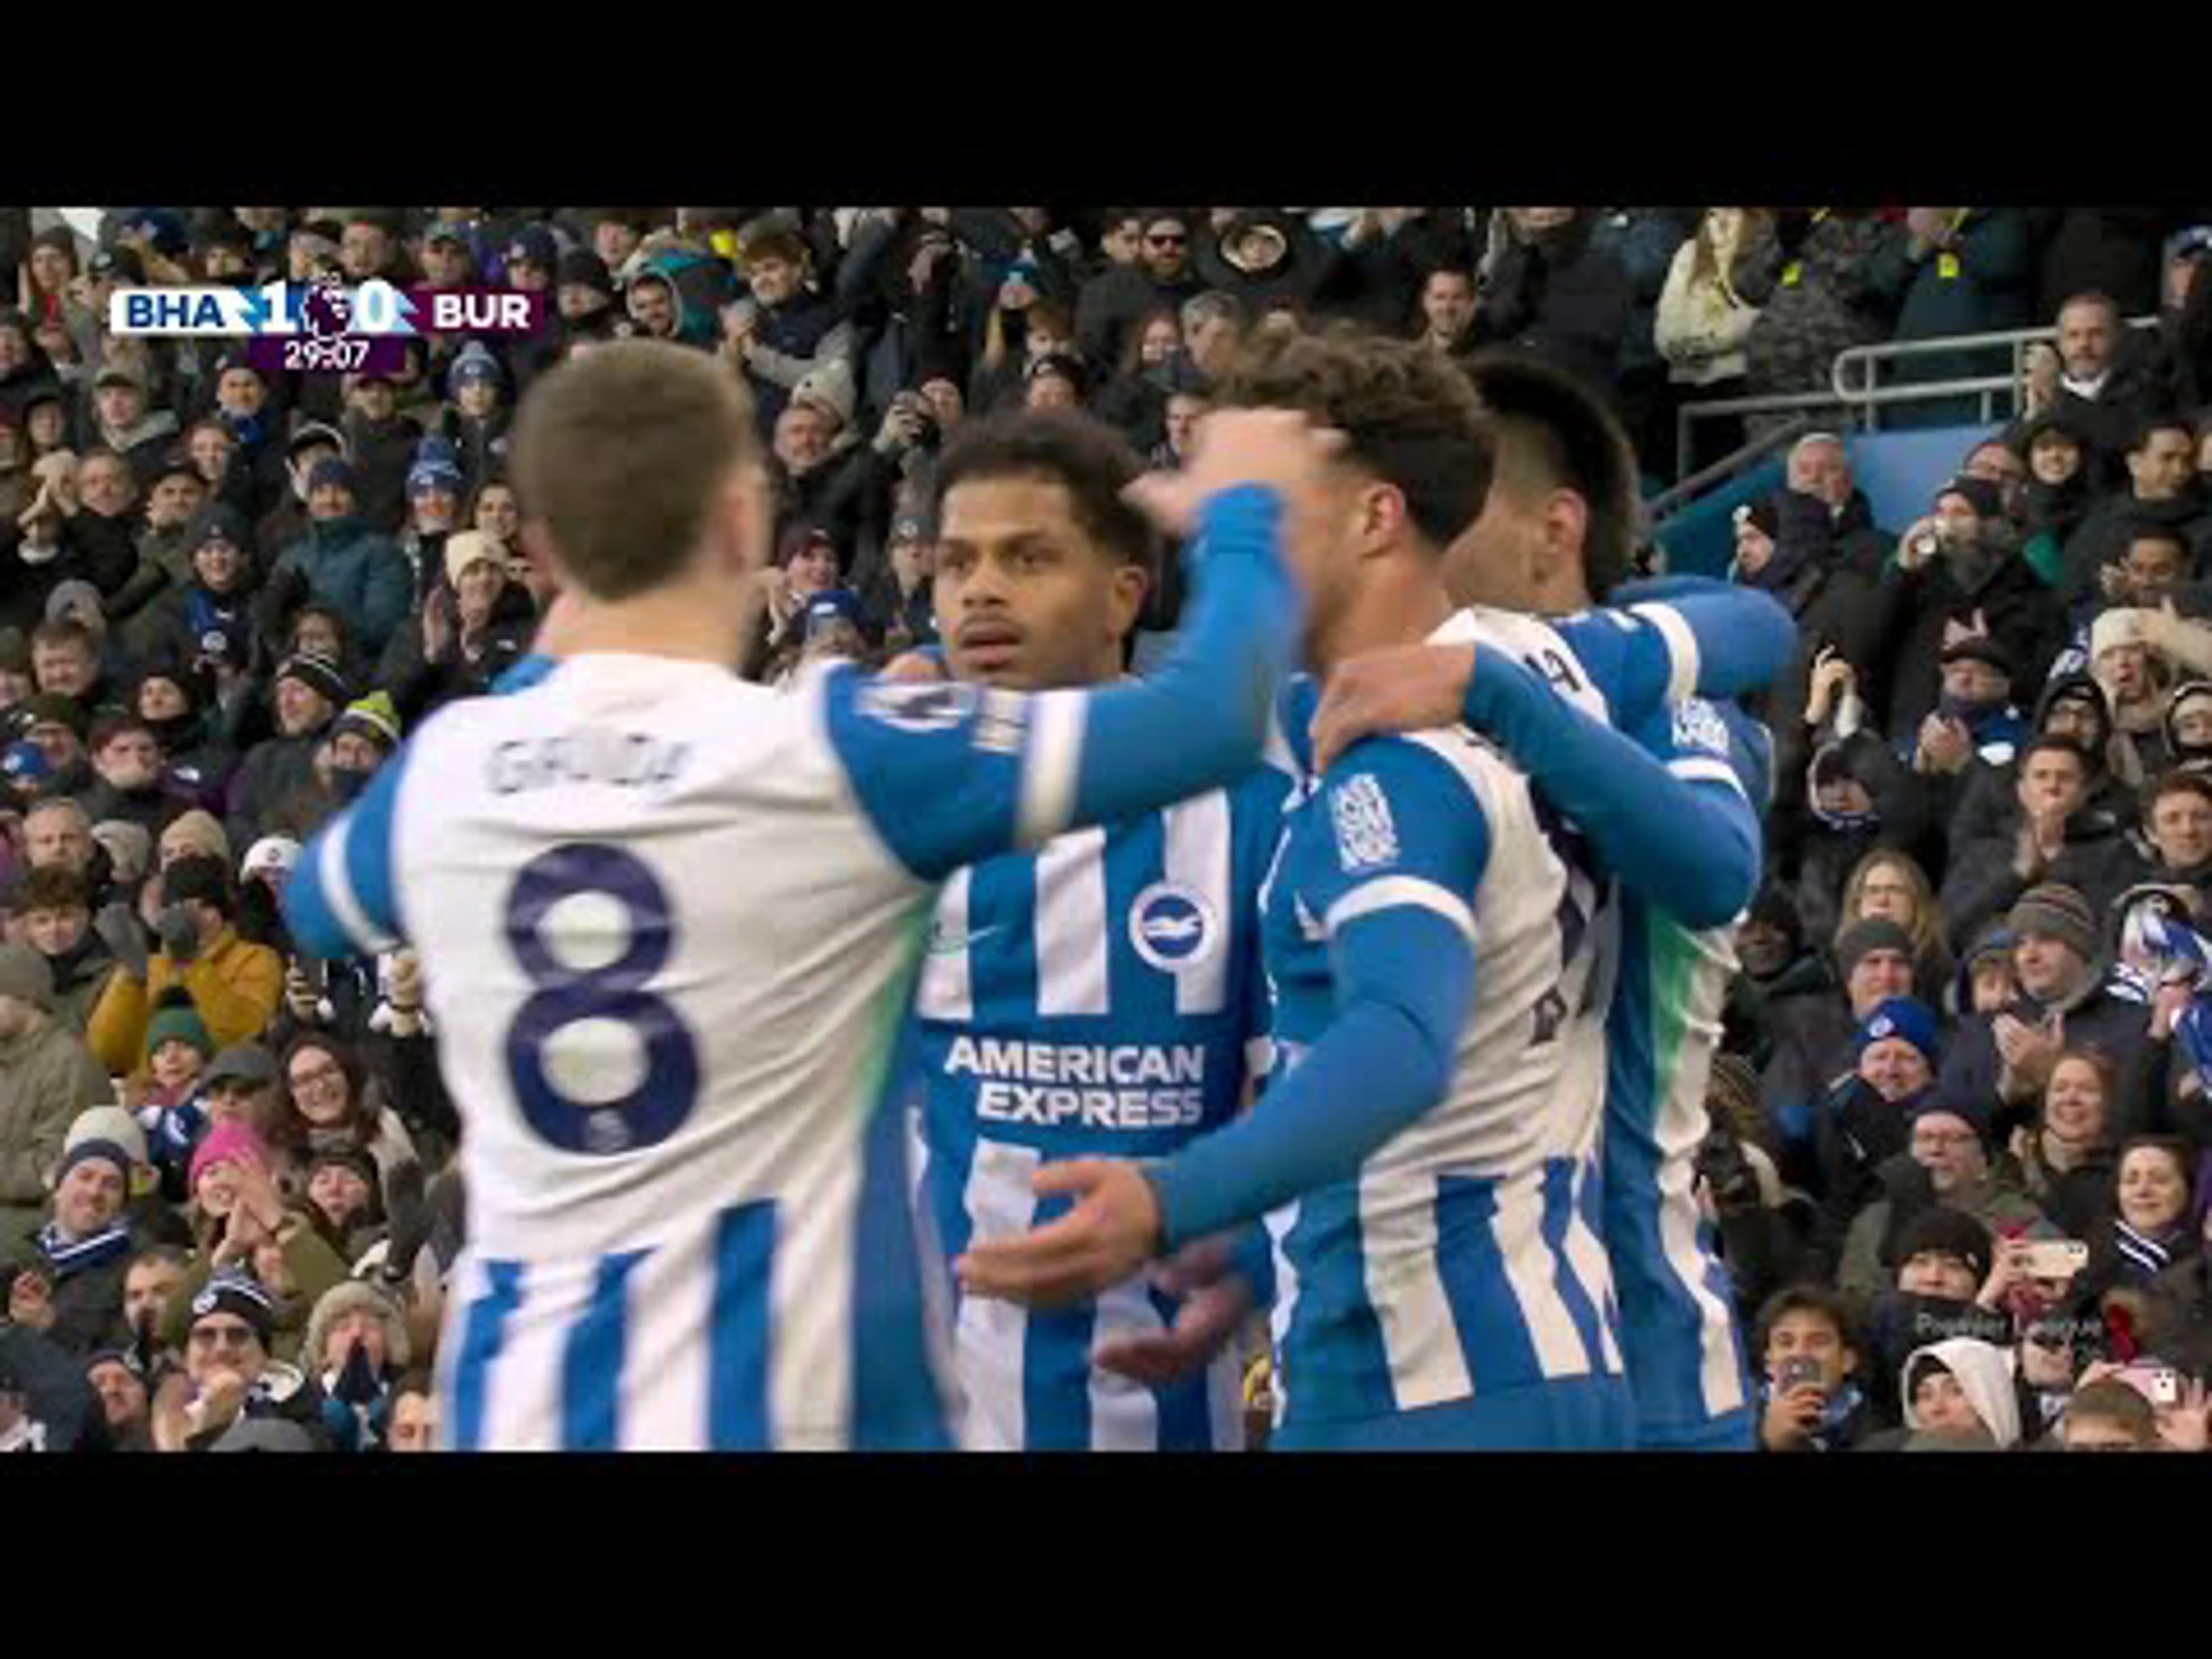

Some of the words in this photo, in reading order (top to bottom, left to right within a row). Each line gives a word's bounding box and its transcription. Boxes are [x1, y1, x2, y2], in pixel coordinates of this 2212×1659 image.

[505, 842, 699, 1154] 8
[945, 1036, 1204, 1084] AMERICAN
[978, 1081, 1204, 1127] EXPRESS
